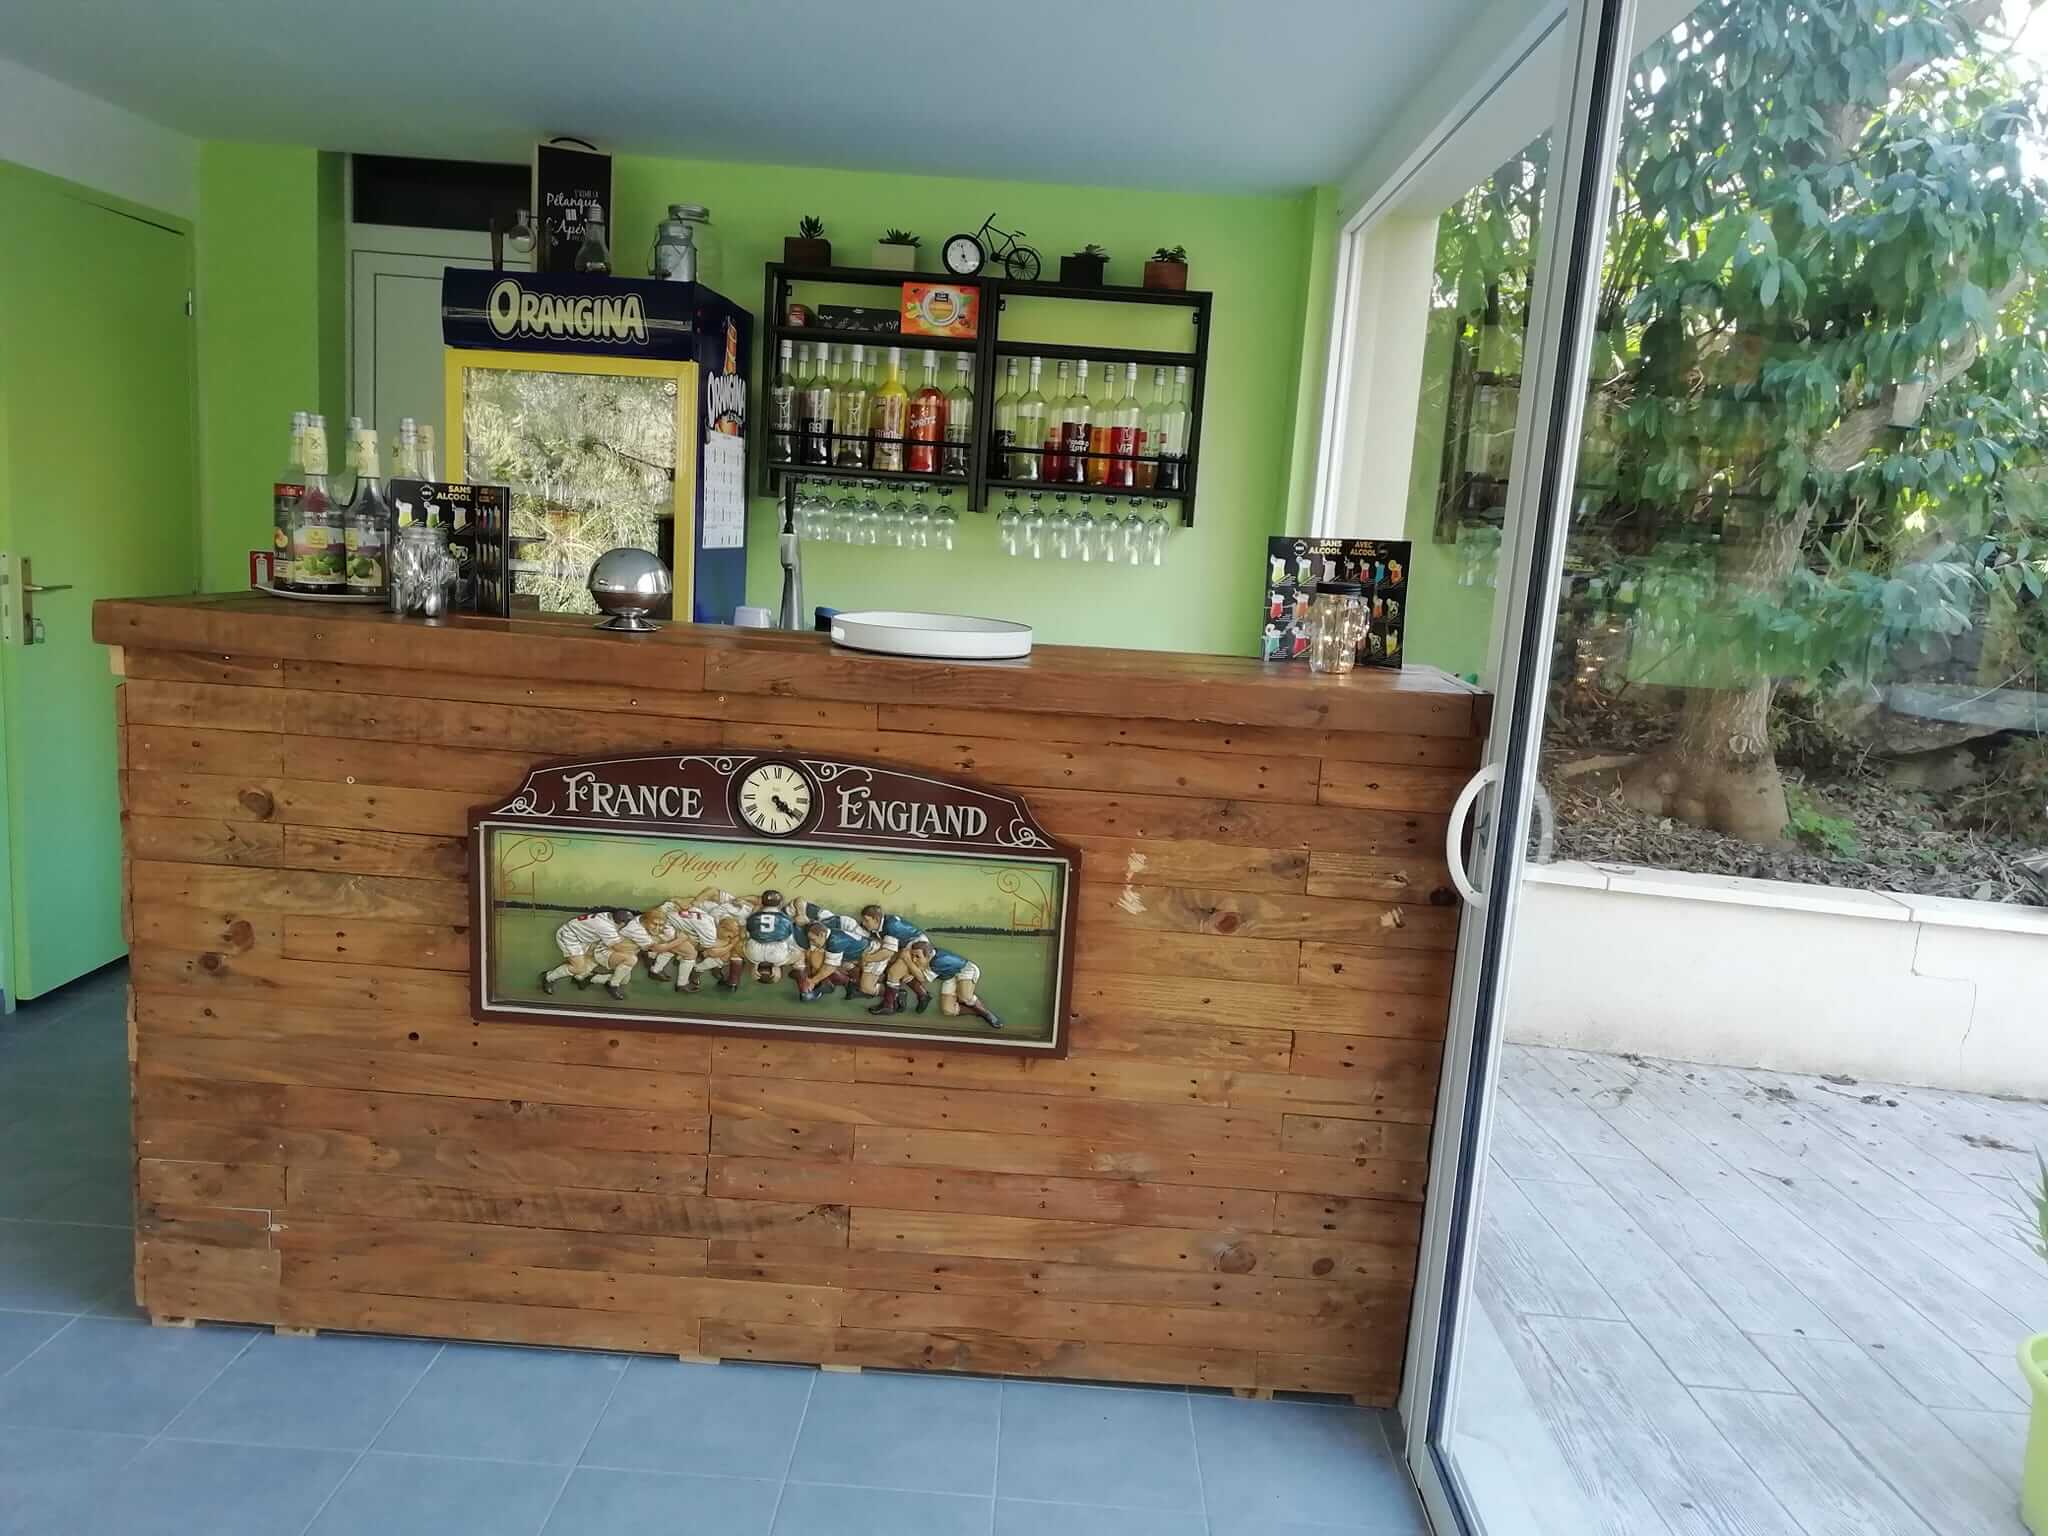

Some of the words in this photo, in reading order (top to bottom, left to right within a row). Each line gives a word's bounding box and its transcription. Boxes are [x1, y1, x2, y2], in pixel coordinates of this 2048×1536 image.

[489, 280, 646, 340] ORANGINA
[448, 485, 472, 494] SANS
[436, 492, 472, 501] ALCOOL
[1319, 540, 1342, 548] SANS
[1354, 541, 1374, 549] AVEC
[1308, 546, 1342, 555] ALCOOL
[1349, 548, 1377, 557] ALCOOL
[562, 771, 703, 819] FRANCE
[836, 785, 988, 838] ENGLAND
[651, 849, 747, 882] Played
[752, 854, 779, 885] by
[788, 854, 902, 895] Gentlemen
[760, 914, 776, 933] 9
